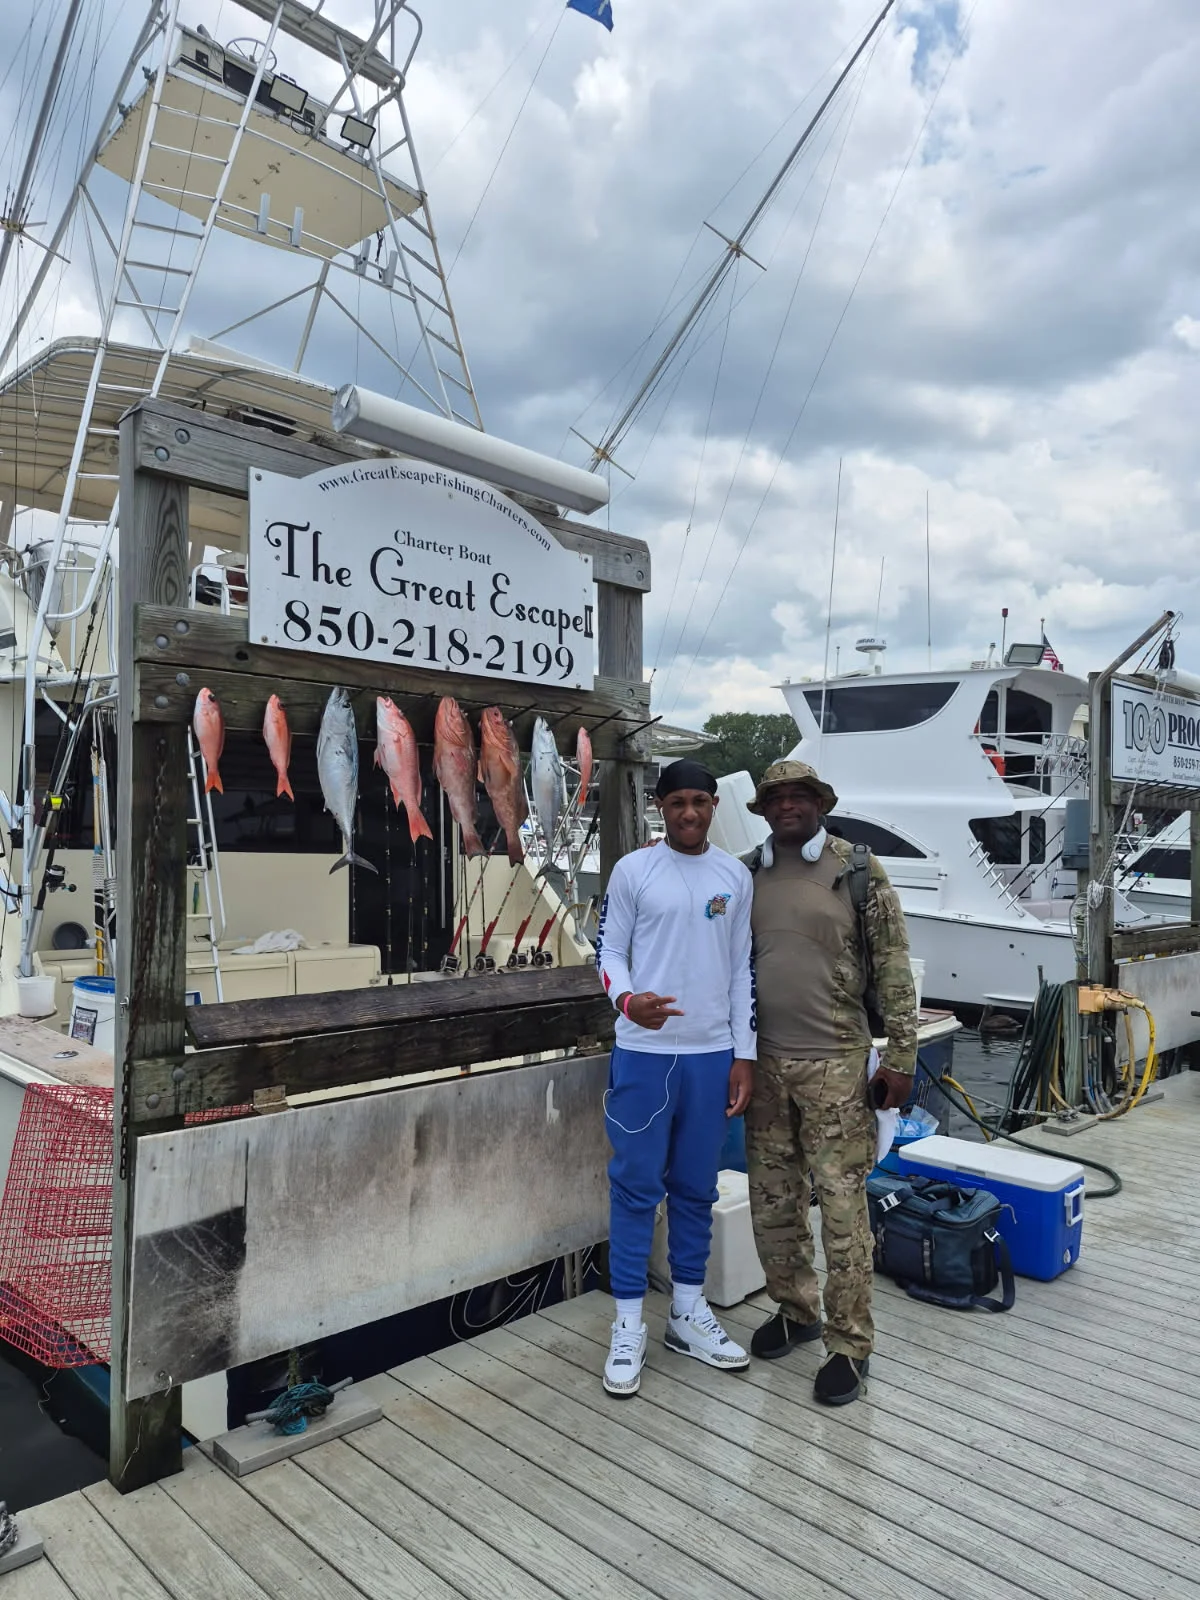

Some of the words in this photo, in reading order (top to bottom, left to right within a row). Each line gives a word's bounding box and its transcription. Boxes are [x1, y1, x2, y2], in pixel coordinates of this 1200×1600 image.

[318, 465, 552, 552] www.GreatEscapeFishingCharters.com
[394, 529, 454, 556] Charter
[458, 543, 492, 566] Boat
[265, 520, 353, 588] The
[369, 546, 476, 612] Great
[283, 599, 574, 680] 850-218-2199
[1123, 700, 1166, 755] 100
